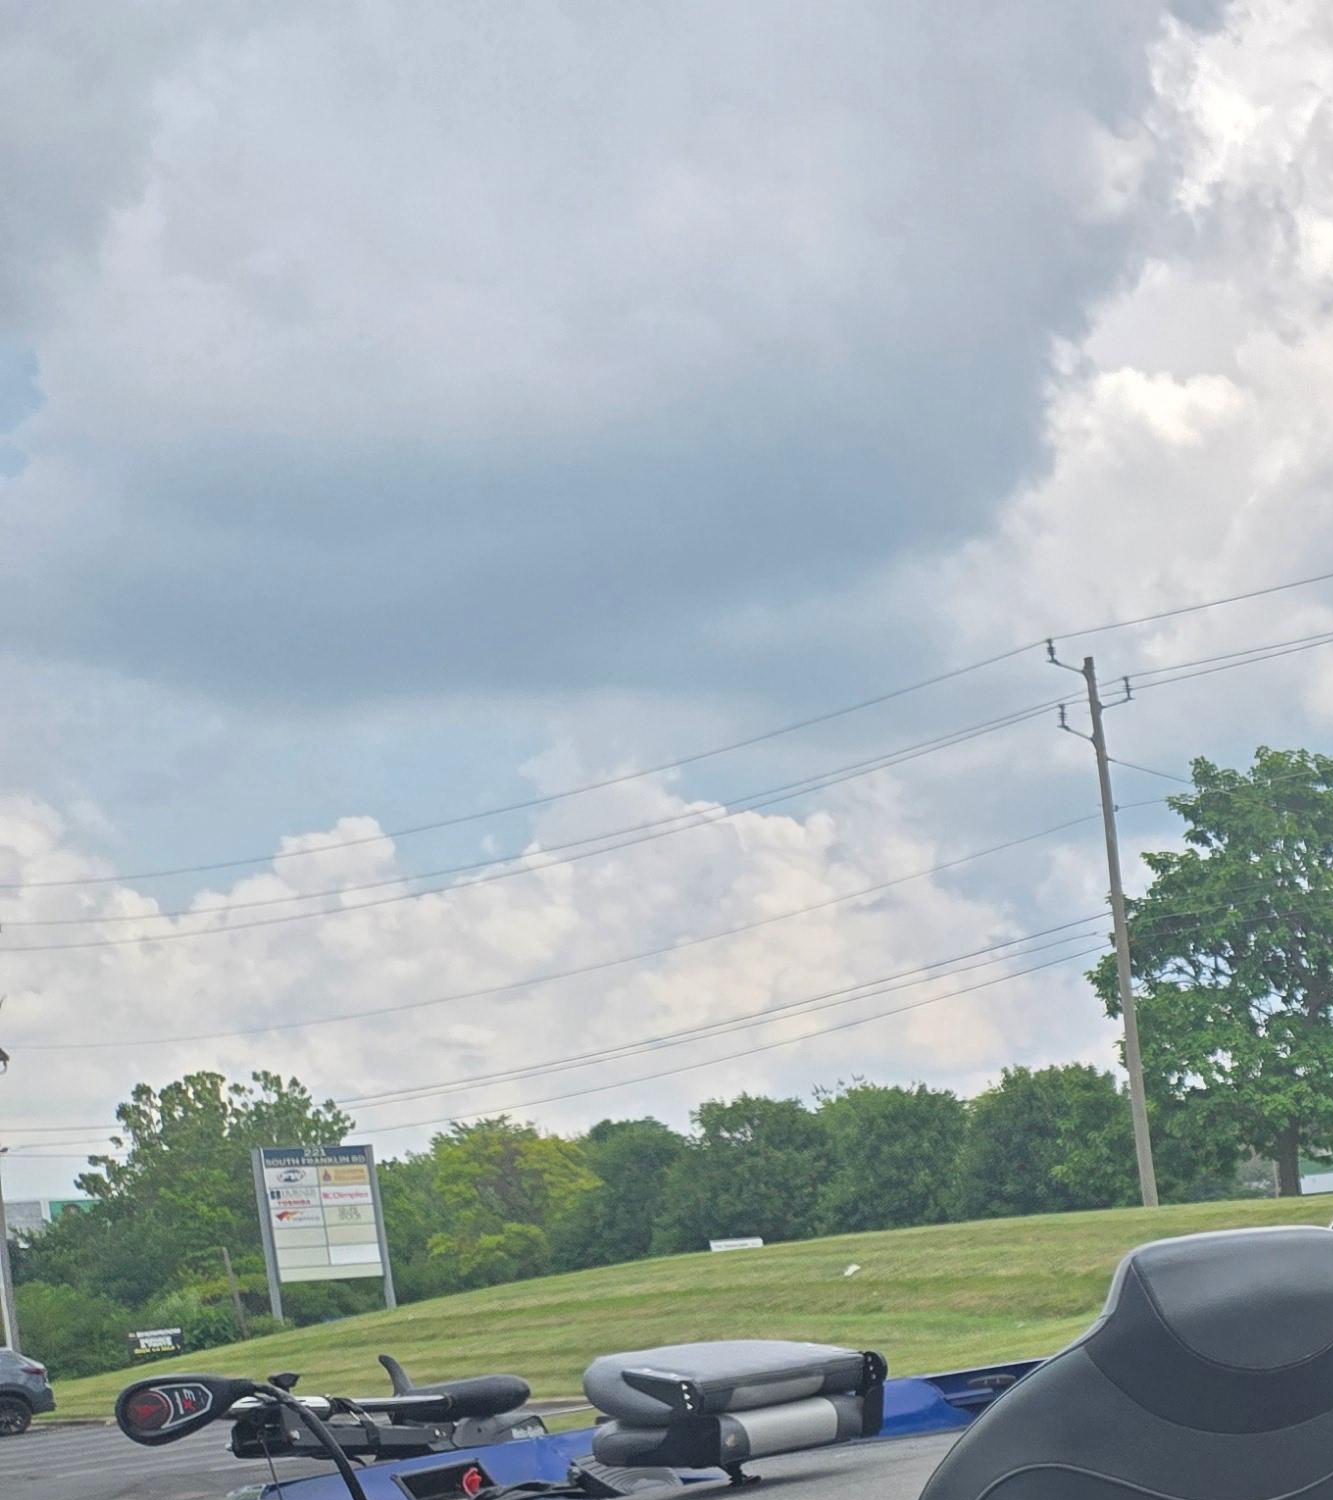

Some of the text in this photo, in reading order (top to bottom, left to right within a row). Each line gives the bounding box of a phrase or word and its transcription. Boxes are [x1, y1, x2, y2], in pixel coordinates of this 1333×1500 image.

[304, 1148, 326, 1158] 221
[266, 1155, 366, 1167] SOUTH FRANKLIN RD
